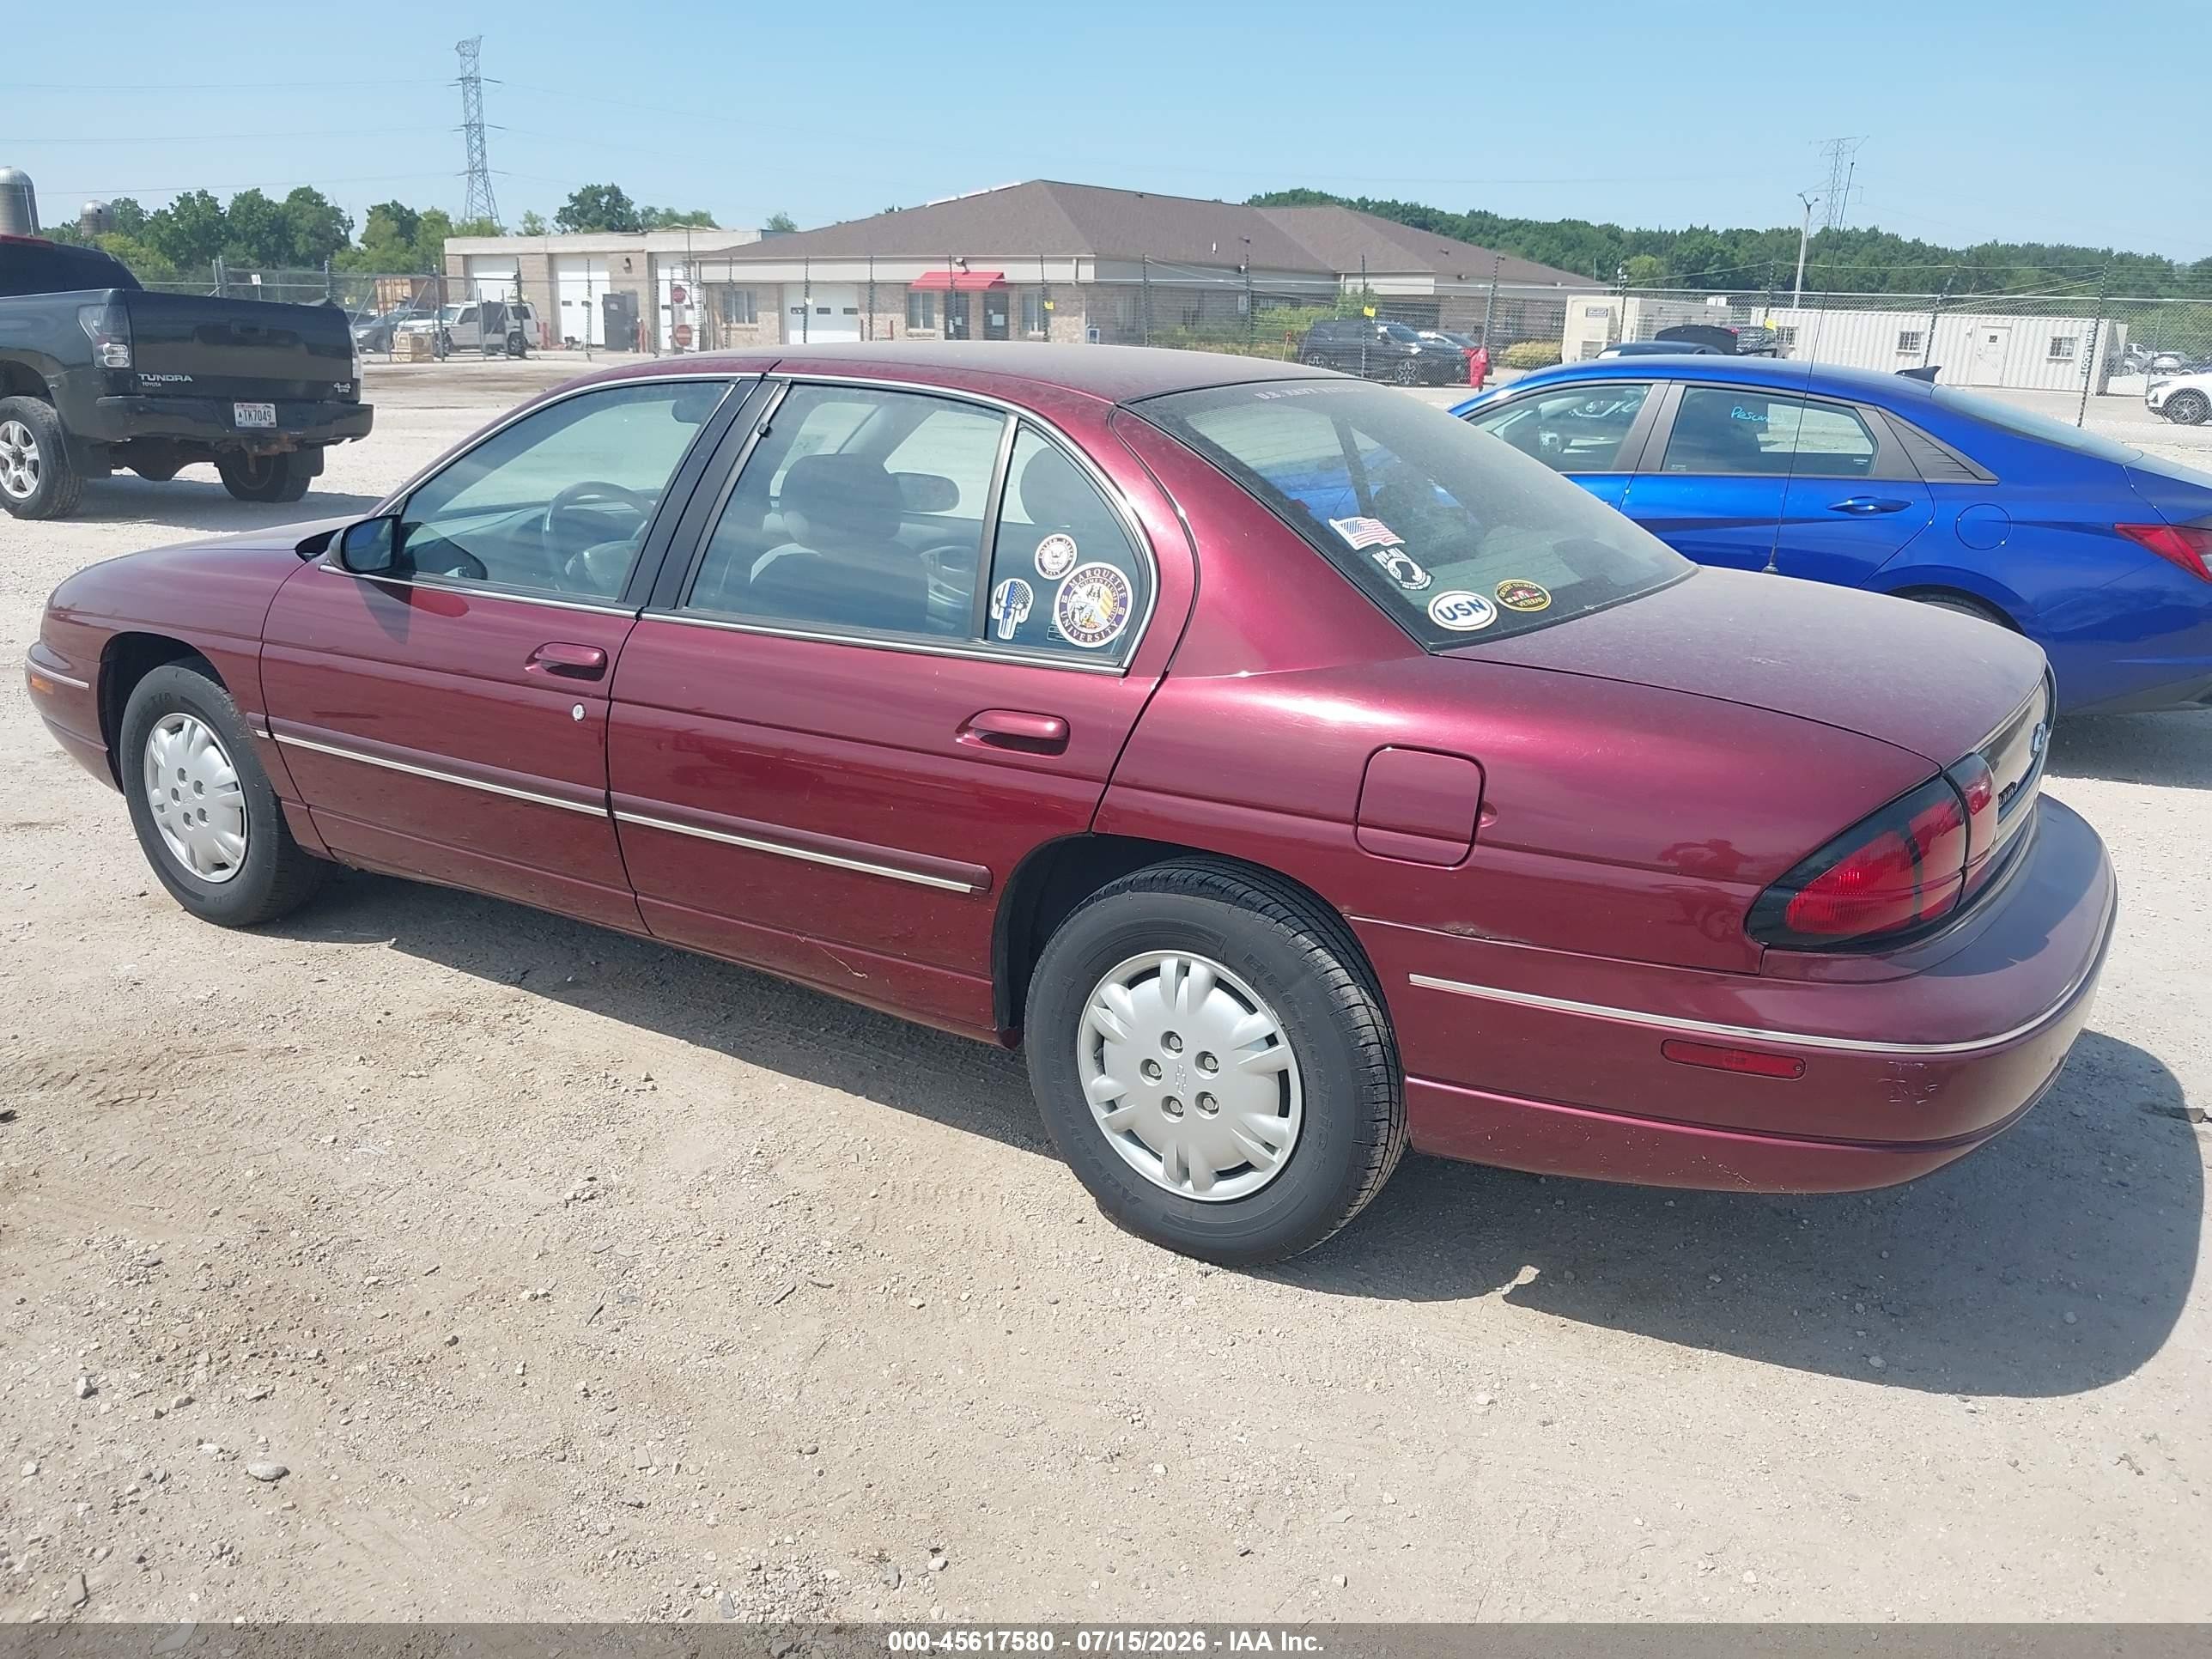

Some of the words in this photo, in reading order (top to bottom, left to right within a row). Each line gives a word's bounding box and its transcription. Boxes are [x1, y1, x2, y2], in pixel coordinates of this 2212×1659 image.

[137, 373, 193, 382] TUNDRA
[1068, 568, 1127, 599] MARQUETTE
[1437, 599, 1488, 621] USN
[1516, 597, 1545, 607] VETERAN
[1060, 611, 1118, 641] UNIVERSITY
